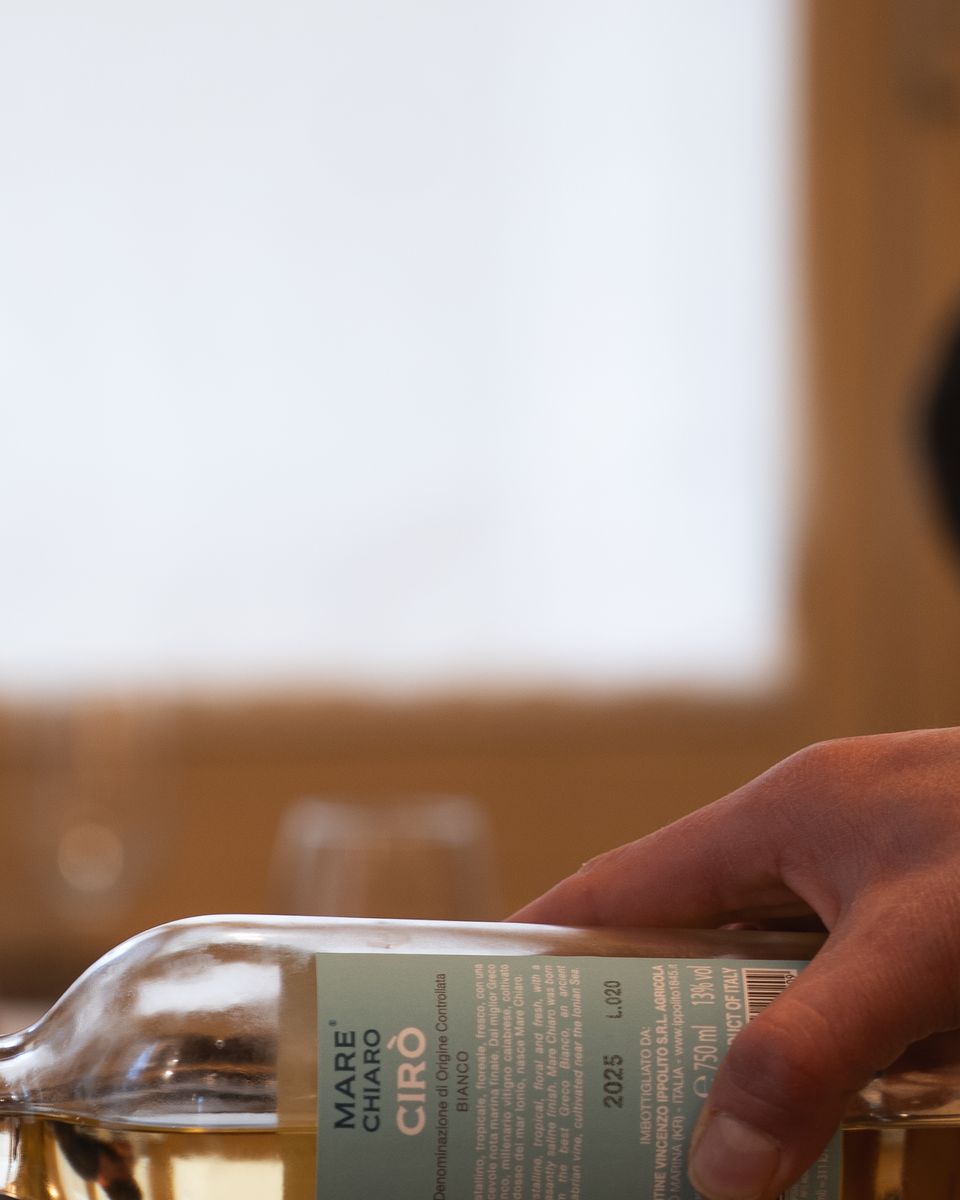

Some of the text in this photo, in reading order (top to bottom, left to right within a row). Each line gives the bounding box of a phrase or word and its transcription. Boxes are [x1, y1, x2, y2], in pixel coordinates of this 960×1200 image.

[474, 964, 484, 978] una
[486, 964, 497, 989] Greco
[499, 964, 511, 1002] coltivato
[531, 974, 542, 992] with
[544, 965, 554, 984] born
[556, 965, 568, 997] ancient
[721, 967, 739, 993] ITALY
[475, 981, 484, 999] con
[546, 988, 555, 1005] was
[571, 988, 582, 1017] Ionian
[651, 965, 666, 1011] AGRICOLA
[724, 995, 741, 1010] OF
[475, 1002, 486, 1038] fresco,
[488, 992, 500, 1026] miglior
[515, 1010, 524, 1036] Mare
[560, 1006, 568, 1018] an
[488, 1029, 499, 1046] Dal
[546, 1009, 556, 1044] Chiaro
[572, 1021, 583, 1038] the
[656, 1014, 668, 1044] S.R.L.
[691, 1026, 718, 1042] ml
[516, 1040, 525, 1074] nasce
[533, 1033, 544, 1054] and
[574, 1041, 583, 1066] near
[603, 980, 622, 1108] 2025 L.020
[693, 1046, 718, 1070] 750
[475, 1042, 487, 1089] floreale,
[533, 1060, 544, 1090] floral
[546, 1048, 557, 1077] Mare
[656, 1047, 669, 1102] IPPOLITO
[333, 1031, 356, 1129] MARE
[362, 1029, 381, 1132] CHIARO
[386, 1027, 427, 1136] CIRÒ
[432, 974, 451, 1200] Denominazione di Origine Controllata
[456, 1051, 469, 1112] BIANCO
[502, 1067, 514, 1106] vitigno
[640, 1026, 652, 1144] IMBOTTIGLIATO DA:
[672, 1067, 684, 1104] ITALIA
[489, 1089, 499, 1130] marina
[559, 1080, 570, 1116] Greco
[572, 1071, 583, 1128] cultivated
[475, 1094, 488, 1150] tropicale,
[516, 1116, 525, 1138] mar
[672, 1116, 687, 1140] (KR)
[489, 1133, 498, 1159] nota
[513, 1143, 524, 1161] del
[546, 1122, 556, 1156] saline
[559, 1128, 569, 1154] best
[656, 1106, 668, 1169] VINCENZO
[558, 1164, 568, 1183] the
[670, 1144, 682, 1192] MARINA
